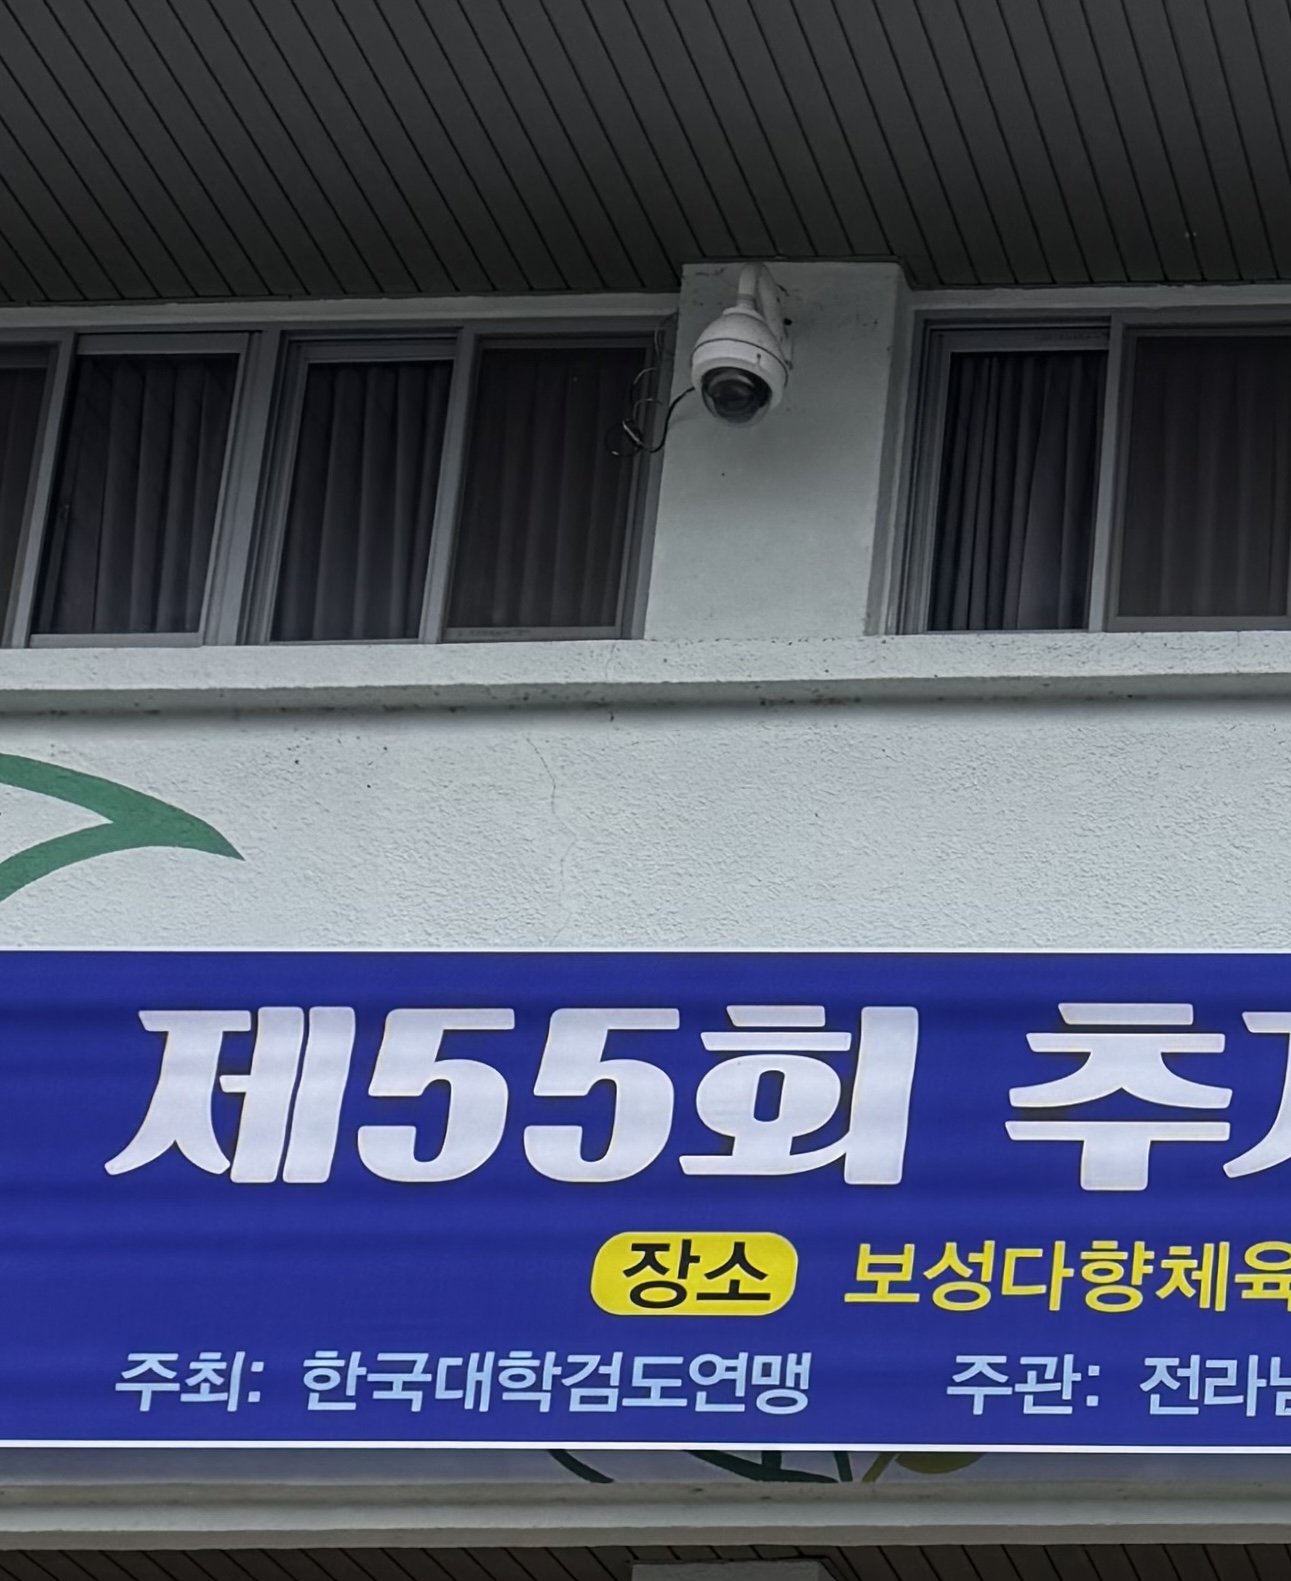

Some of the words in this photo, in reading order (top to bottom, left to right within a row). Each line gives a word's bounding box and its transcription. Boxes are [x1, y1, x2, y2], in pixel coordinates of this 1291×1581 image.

[104, 1003, 920, 1186] 제55회
[622, 1238, 773, 1309] 장소
[115, 1351, 265, 1412] 주최:
[303, 1350, 812, 1415] 한국대학검도연맹
[946, 1353, 1100, 1416] 주관:
